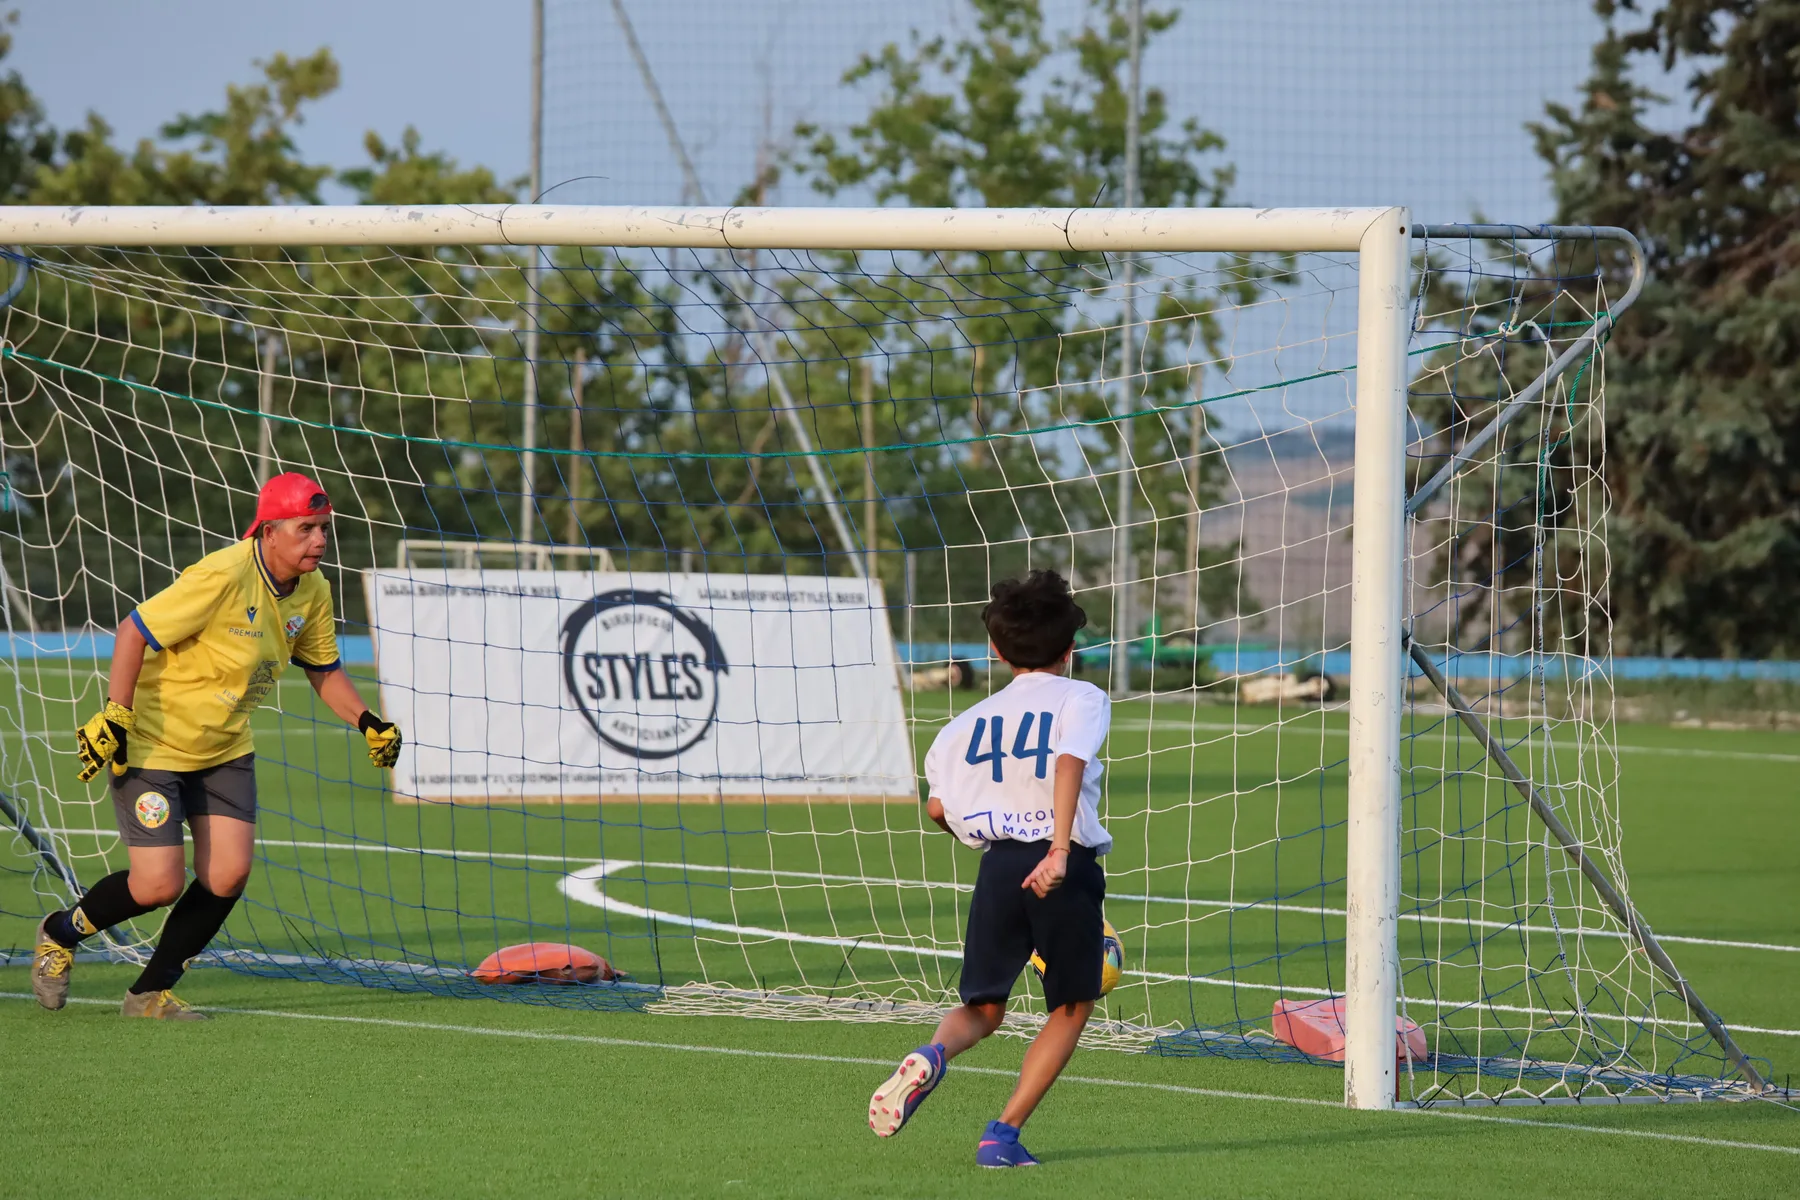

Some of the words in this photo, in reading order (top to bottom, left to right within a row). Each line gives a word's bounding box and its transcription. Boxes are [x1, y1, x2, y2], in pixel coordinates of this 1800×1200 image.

[228, 627, 264, 638] PREMIATA
[584, 653, 703, 700] STYLES
[965, 711, 1054, 783] 44
